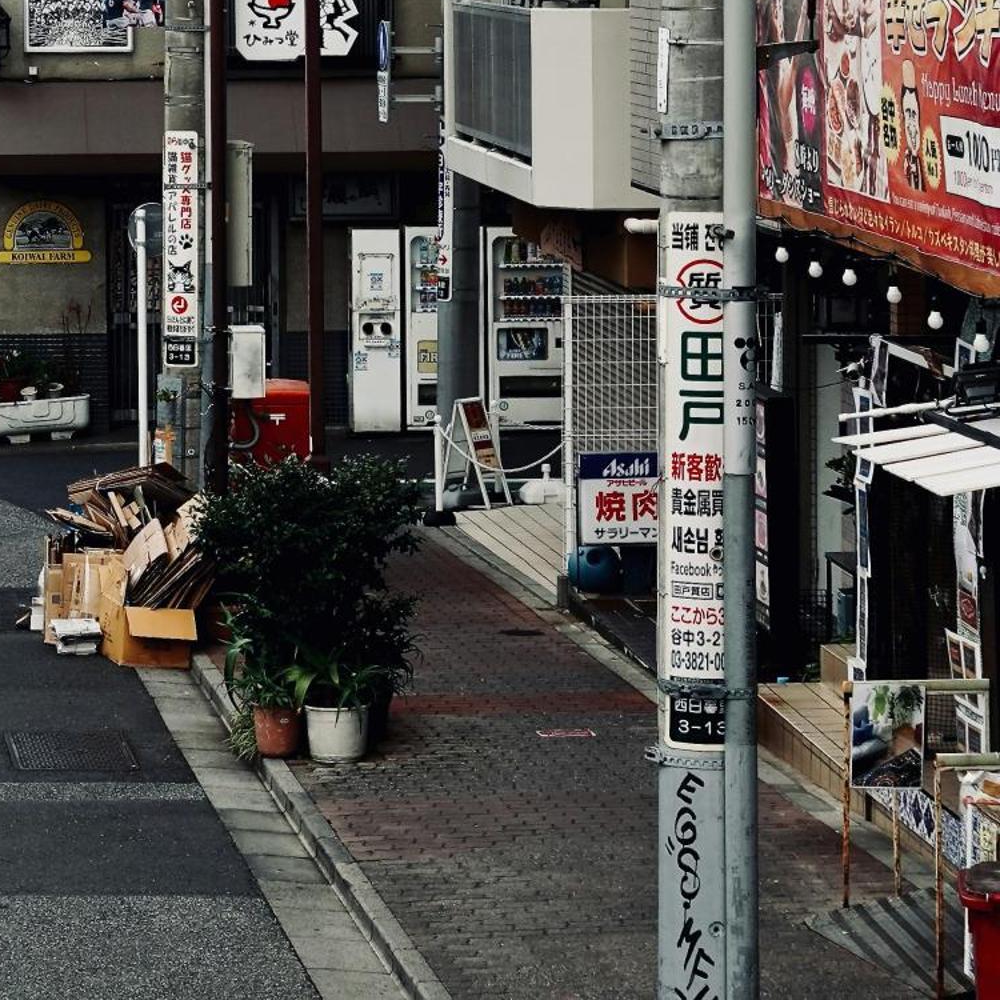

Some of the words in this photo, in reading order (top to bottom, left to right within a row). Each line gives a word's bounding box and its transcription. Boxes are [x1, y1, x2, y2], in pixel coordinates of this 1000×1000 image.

[921, 73, 951, 108] Happy
[11, 252, 45, 261] KOIWAI
[49, 252, 75, 261] FARM
[602, 458, 650, 478] Asahi
[595, 490, 658, 522] 焼肉
[671, 525, 709, 555] 새손님
[671, 561, 712, 577] Facebook
